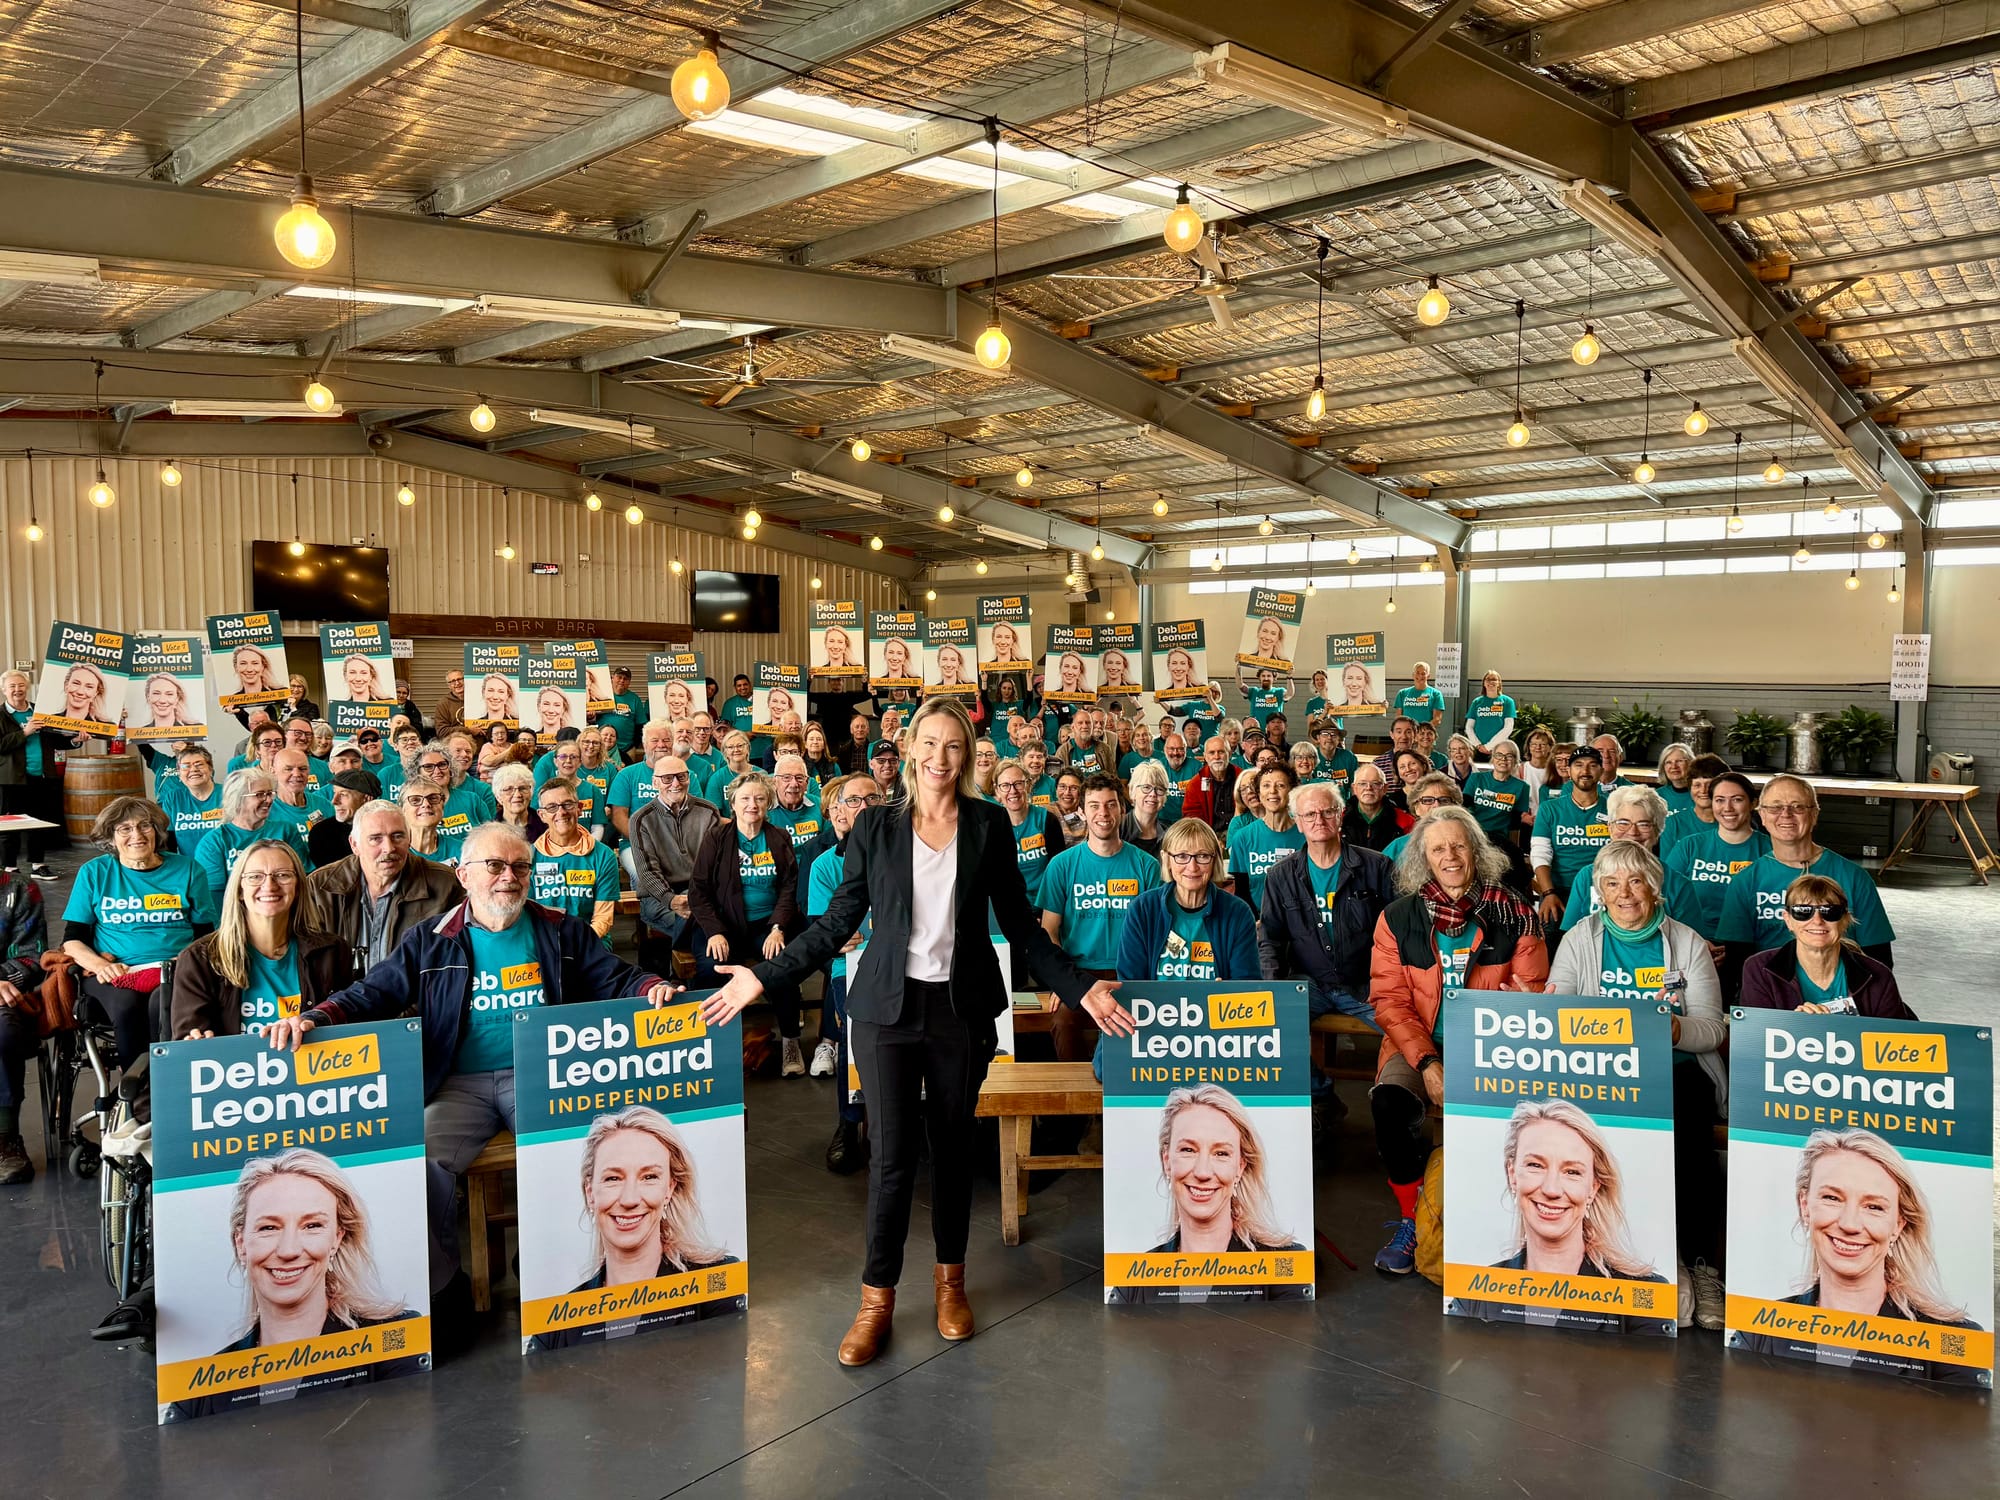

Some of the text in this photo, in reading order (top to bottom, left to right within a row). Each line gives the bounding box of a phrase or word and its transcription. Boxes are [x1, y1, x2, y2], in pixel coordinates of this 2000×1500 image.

[1256, 590, 1277, 601] Deb
[816, 603, 836, 611] Deb
[983, 599, 1002, 608] Deb
[1255, 598, 1296, 613] Leonard
[816, 610, 855, 619] Leonard
[983, 606, 1022, 615] Leonard
[216, 618, 244, 629] Deb
[876, 614, 896, 622] Deb
[495, 620, 595, 633] BARN BARR
[876, 622, 916, 630] Leonard
[928, 621, 948, 629] Deb
[1157, 625, 1177, 634] Deb
[62, 628, 93, 643] Deb
[218, 624, 272, 639] Leonard
[329, 627, 354, 638] Deb
[928, 627, 968, 637] Leonard
[1054, 628, 1073, 636] Deb
[1158, 630, 1197, 642] Leonard
[220, 636, 273, 646] INDEPENDENT
[330, 635, 381, 647] Leonard
[1053, 635, 1093, 645] Leonard
[1100, 634, 1135, 643] eonard
[1334, 637, 1354, 647] Deb
[60, 638, 123, 660] Leonard
[331, 646, 382, 654] INDEPENDENT
[472, 647, 496, 656] Deb
[552, 643, 575, 652] Deb
[1334, 644, 1376, 655] Leonard
[58, 651, 121, 667] INDEPENDENT
[132, 653, 191, 664] Leonard
[528, 659, 552, 668] Deb
[654, 655, 675, 664] Deb
[132, 665, 193, 673] INDEPENDENT
[528, 668, 577, 678] Leonard
[654, 663, 697, 672] Leonard
[760, 664, 780, 673] Deb
[760, 672, 800, 682] Leonard
[338, 705, 364, 716] Deb
[337, 715, 391, 728] Leonard
[176, 812, 201, 822] Deb
[1556, 825, 1584, 836] Deb
[1249, 852, 1276, 864] Deb
[1693, 858, 1728, 873] Deb
[569, 873, 586, 881] Vote
[1691, 870, 1731, 884] Leon
[1073, 881, 1106, 897] Deb
[1112, 883, 1129, 893] Vote
[101, 896, 142, 910] Deb
[150, 897, 171, 907] Vote
[1074, 897, 1131, 910] Leonar
[101, 910, 184, 924] Leonard
[508, 968, 533, 985] Vote
[1601, 967, 1632, 985] eb
[241, 998, 275, 1018] eb
[1131, 998, 1267, 1028] Deb Vote 1
[1475, 1008, 1624, 1041] Deb Vote 1
[548, 1012, 697, 1056] Deb Vote 1
[1132, 1028, 1281, 1058] Leonard
[1766, 1029, 1937, 1066] Deb Vote 1
[549, 1040, 712, 1089] Leonard
[1475, 1039, 1639, 1078] Leonard
[191, 1045, 370, 1094] Deb Vote 1
[1133, 1067, 1281, 1082] INDEPENDENT
[1476, 1079, 1640, 1102] INDEPENDENT
[1766, 1061, 1954, 1110] Leonard
[551, 1079, 713, 1113] INDEPENDENT
[192, 1075, 387, 1131] Leonard
[1766, 1103, 1955, 1136] INDEPENDENT
[194, 1118, 388, 1158] INDEPENDENT
[1127, 1258, 1267, 1279] MoreForMonash
[1468, 1275, 1623, 1304] MoreForMonash
[548, 1277, 699, 1324] MoreForMonash
[1753, 1308, 1930, 1349] MoreForMonash
[190, 1335, 372, 1389] MoreForMonash
